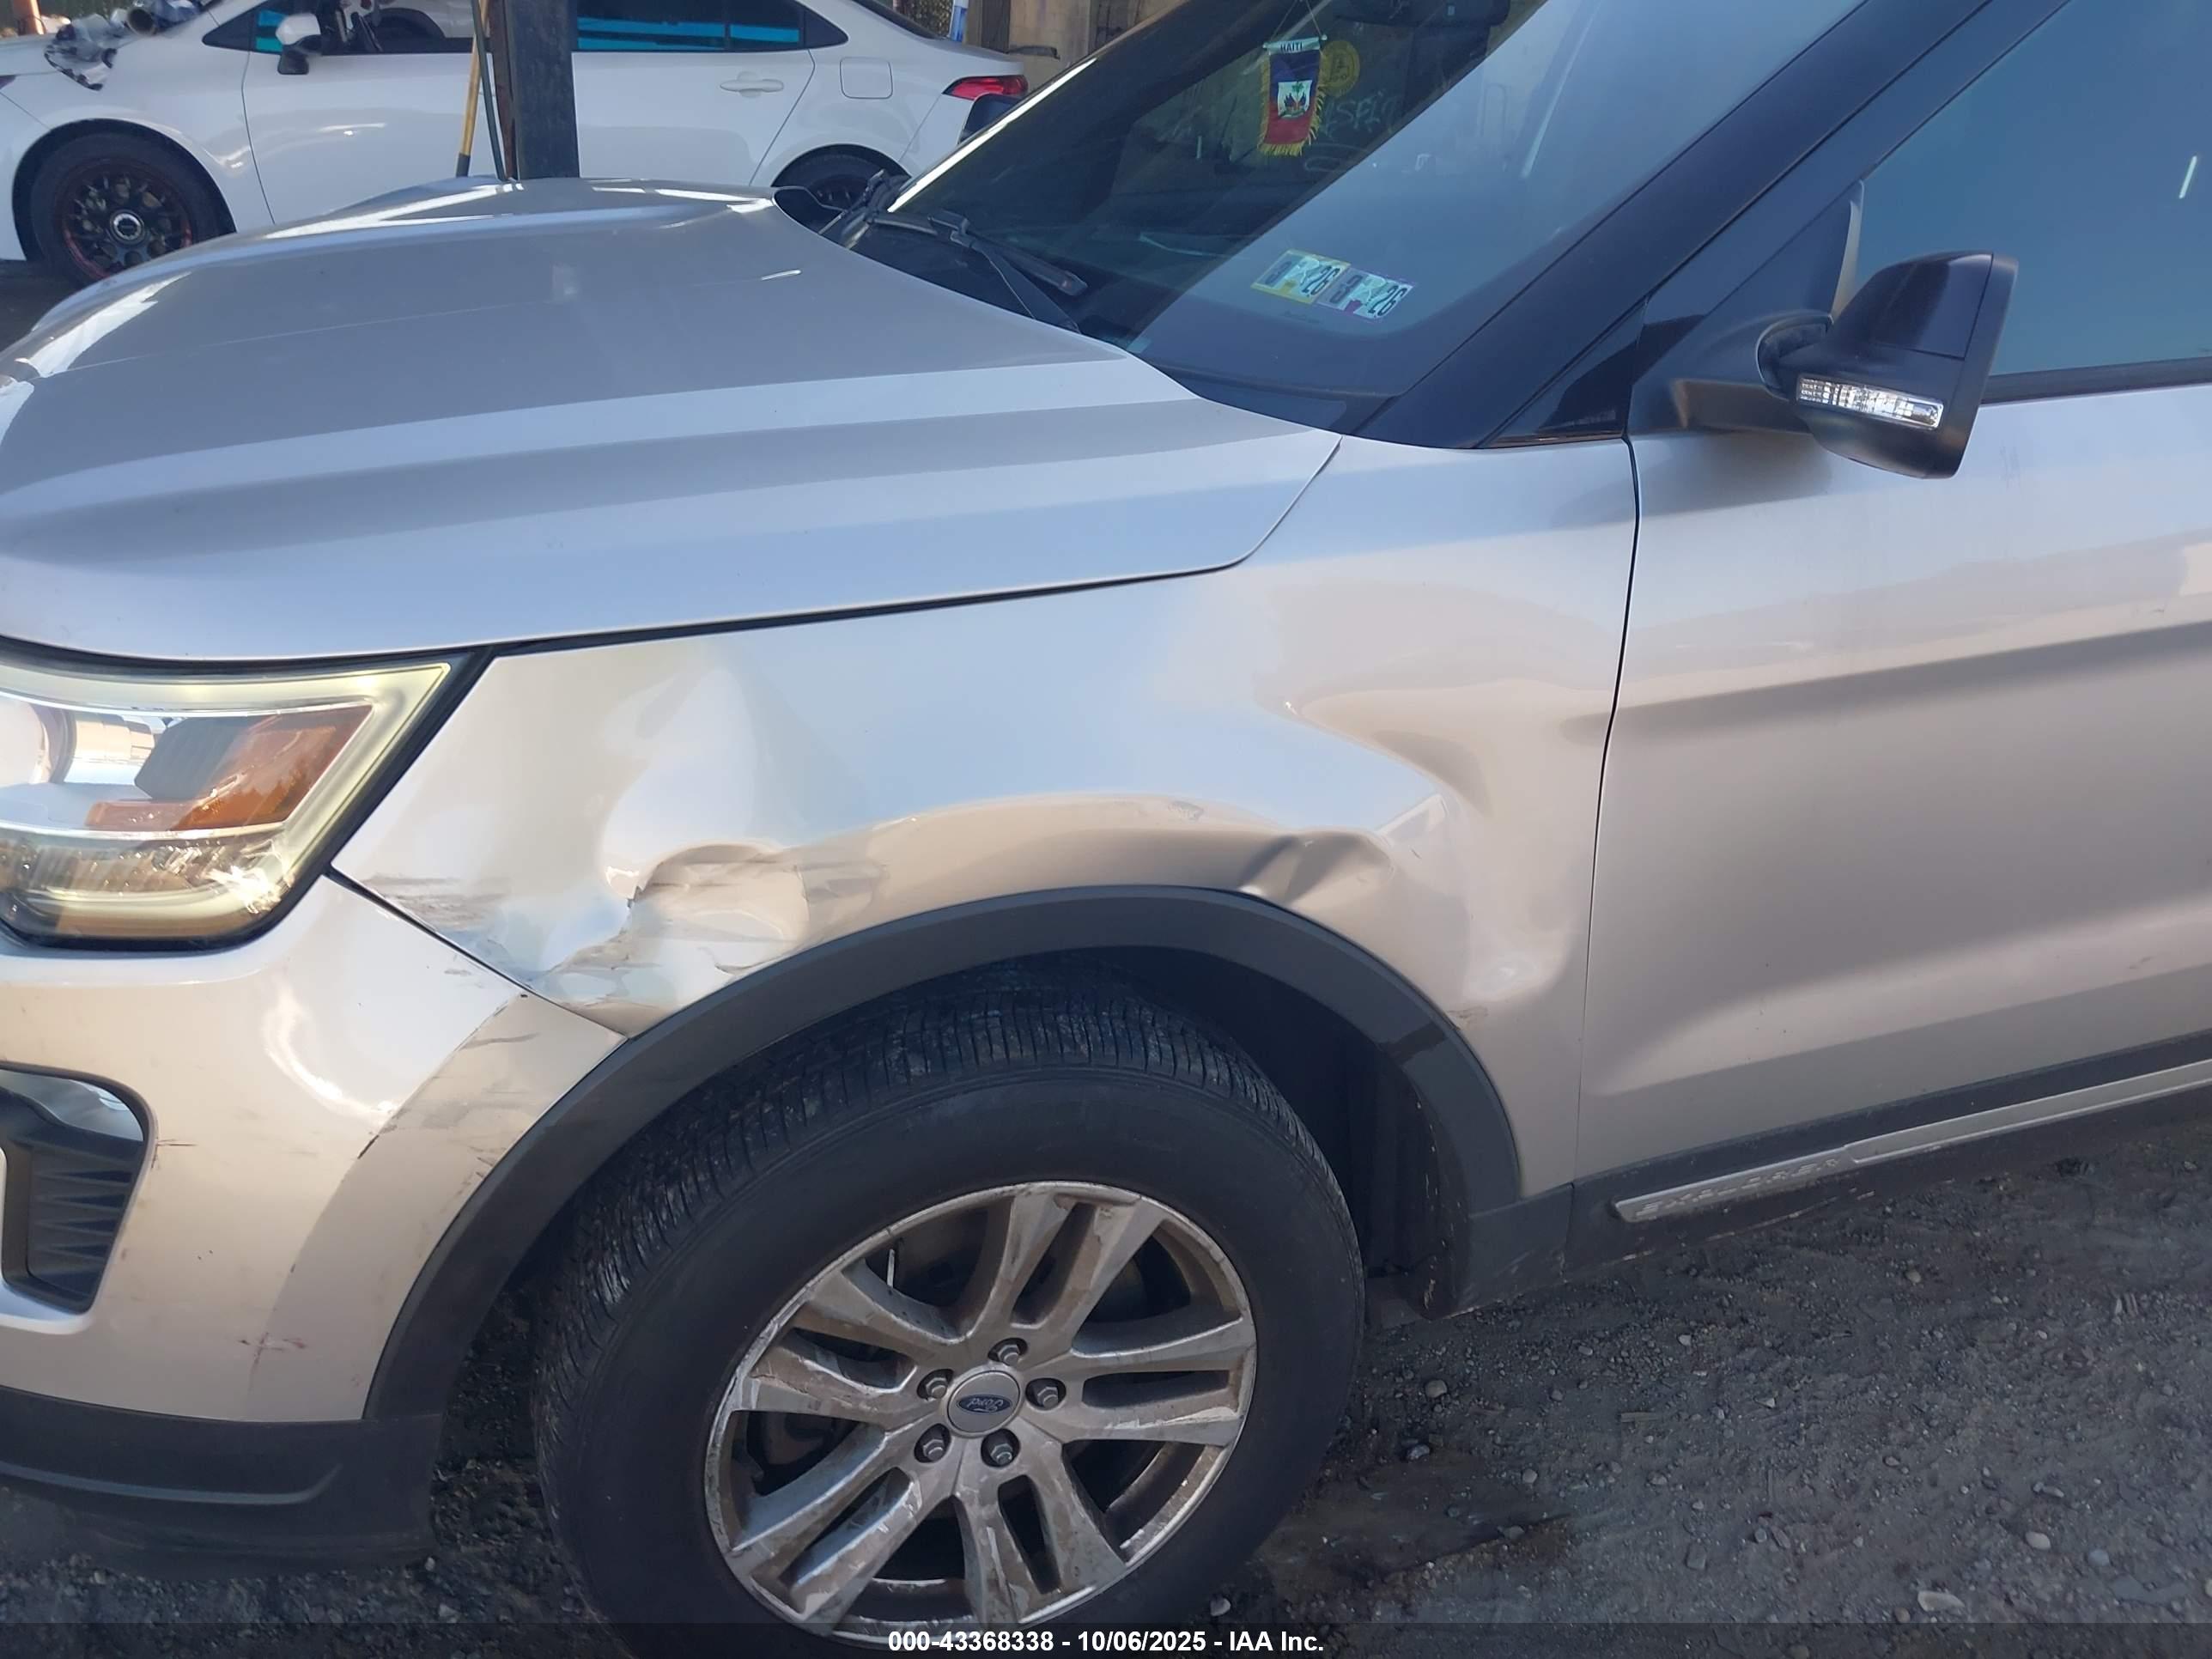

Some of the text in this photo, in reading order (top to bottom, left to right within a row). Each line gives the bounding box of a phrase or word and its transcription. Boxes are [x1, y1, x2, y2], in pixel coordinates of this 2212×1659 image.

[1280, 40, 1304, 52] HAITI
[1368, 284, 1408, 317] 26
[966, 1396, 1004, 1413] Ford
